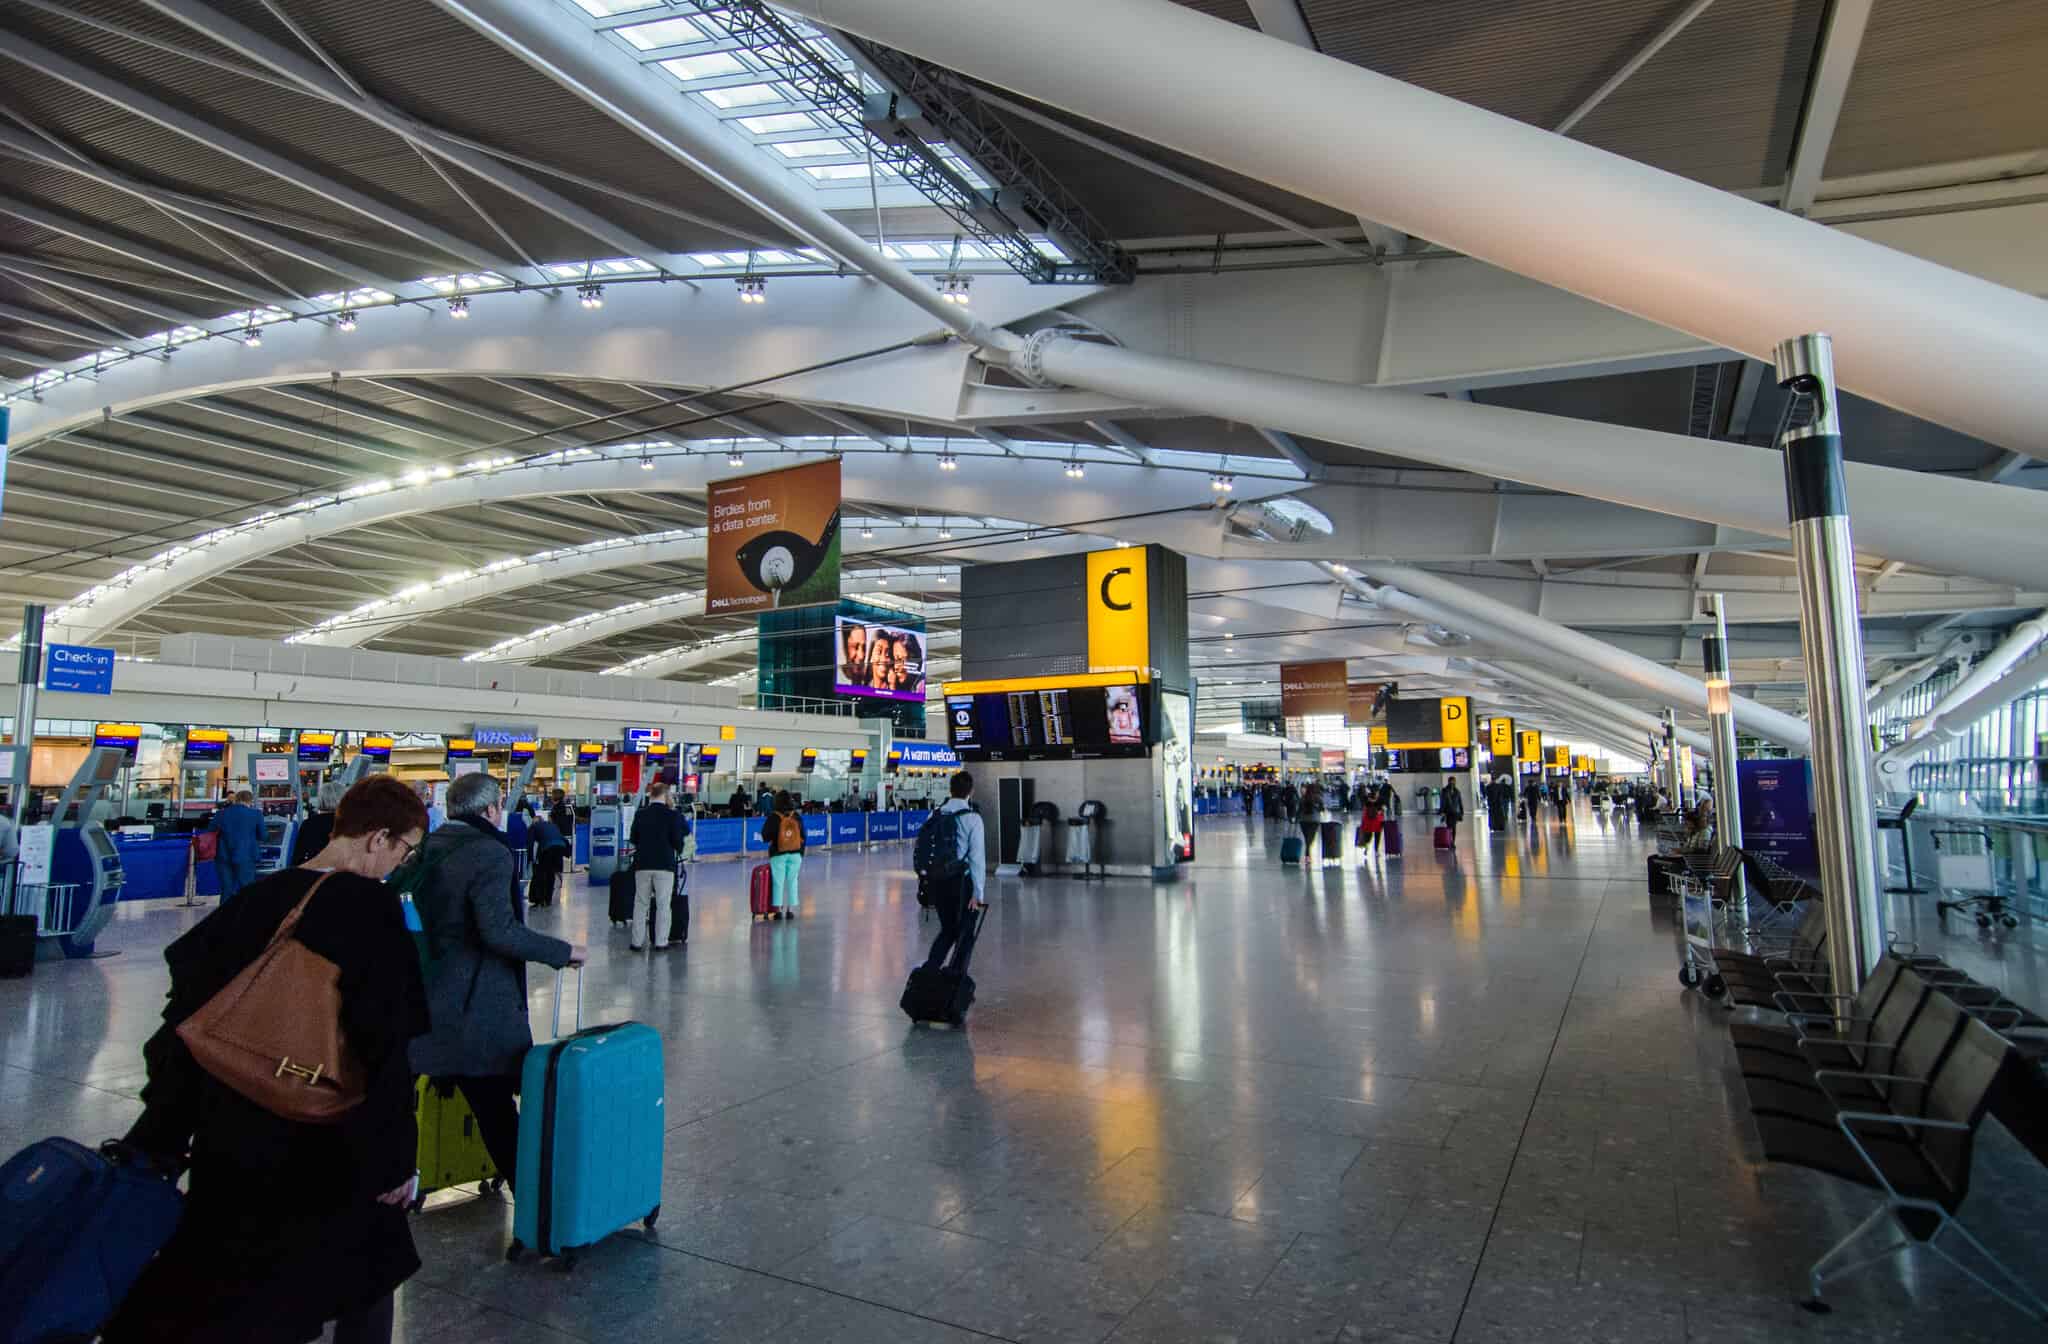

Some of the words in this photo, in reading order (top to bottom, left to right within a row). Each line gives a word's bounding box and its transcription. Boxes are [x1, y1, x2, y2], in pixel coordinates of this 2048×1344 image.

[714, 503, 745, 519] Birdies
[747, 497, 771, 512] from
[713, 523, 720, 533] a
[722, 519, 744, 532] data
[1101, 567, 1132, 611] C
[54, 649, 109, 665] Check-in
[1447, 704, 1462, 720] D
[475, 729, 535, 745] WHSmith
[1527, 735, 1535, 745] F
[903, 746, 910, 761] A
[911, 750, 931, 761] warm
